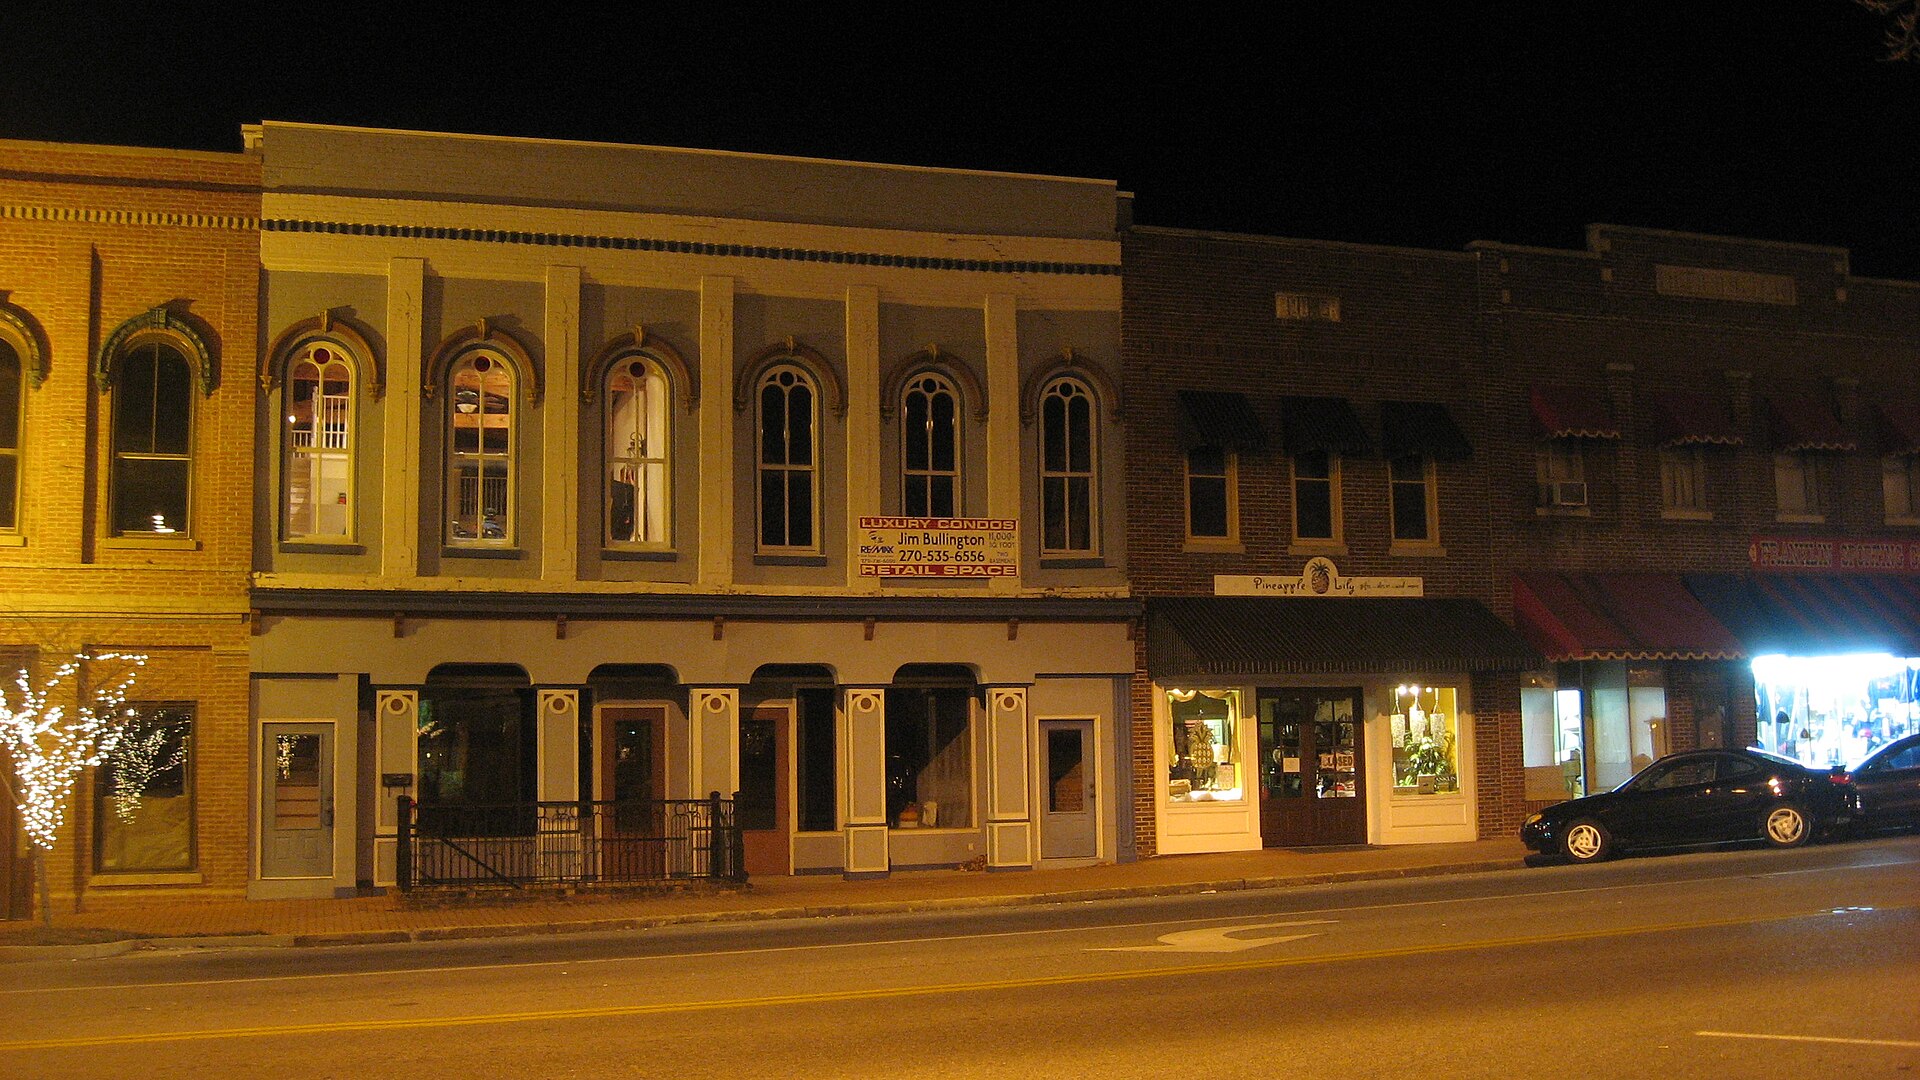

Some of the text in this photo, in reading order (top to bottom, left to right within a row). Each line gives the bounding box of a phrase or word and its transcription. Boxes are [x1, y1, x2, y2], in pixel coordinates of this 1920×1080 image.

[861, 518, 1015, 530] LUXURY CONDOS
[898, 532, 985, 549] Jim Bullington
[860, 545, 894, 554] RE/MAX
[899, 549, 985, 562] 270-535-6556
[861, 564, 1015, 576] RETAIL SPACE
[1253, 577, 1355, 595] Pineapple Lily
